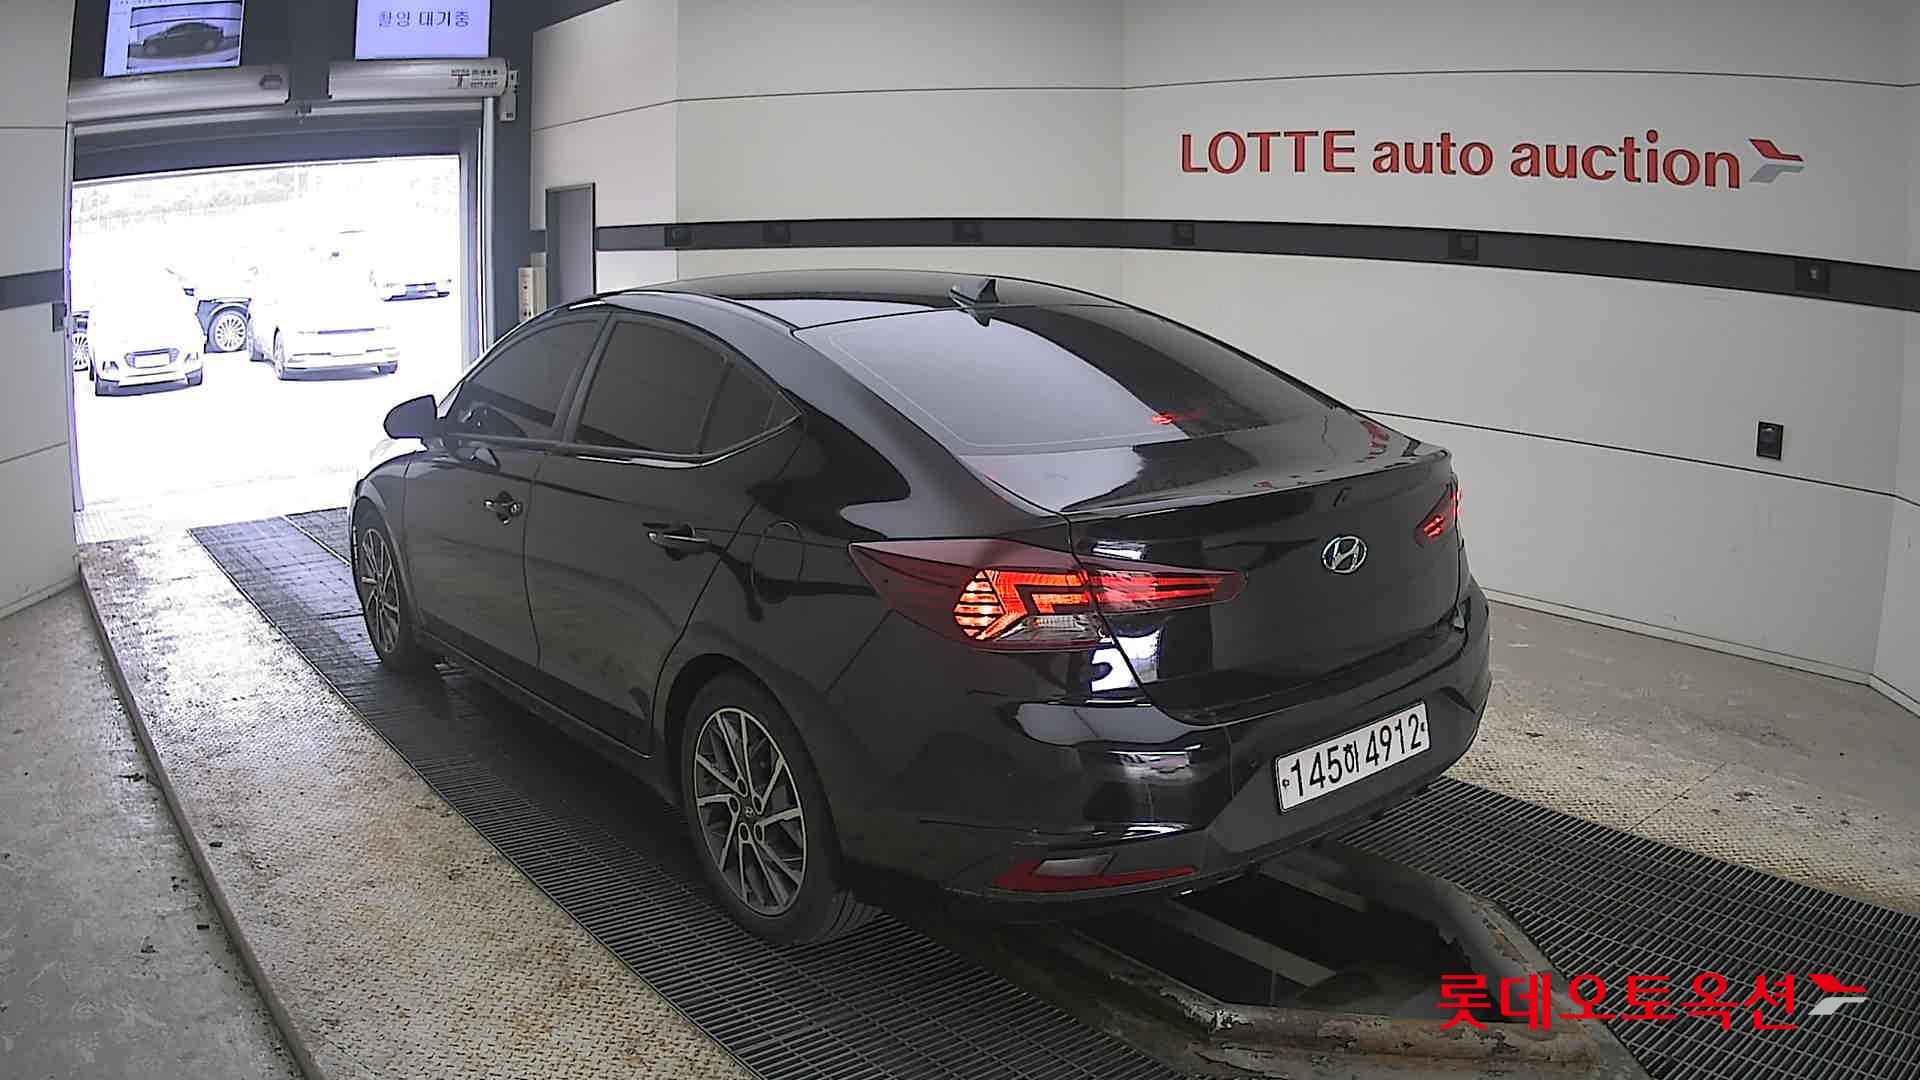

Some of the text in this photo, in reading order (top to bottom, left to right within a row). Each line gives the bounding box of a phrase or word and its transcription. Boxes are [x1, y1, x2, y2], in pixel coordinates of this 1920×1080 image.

[1181, 129, 1740, 189] LOTTE auto auction
